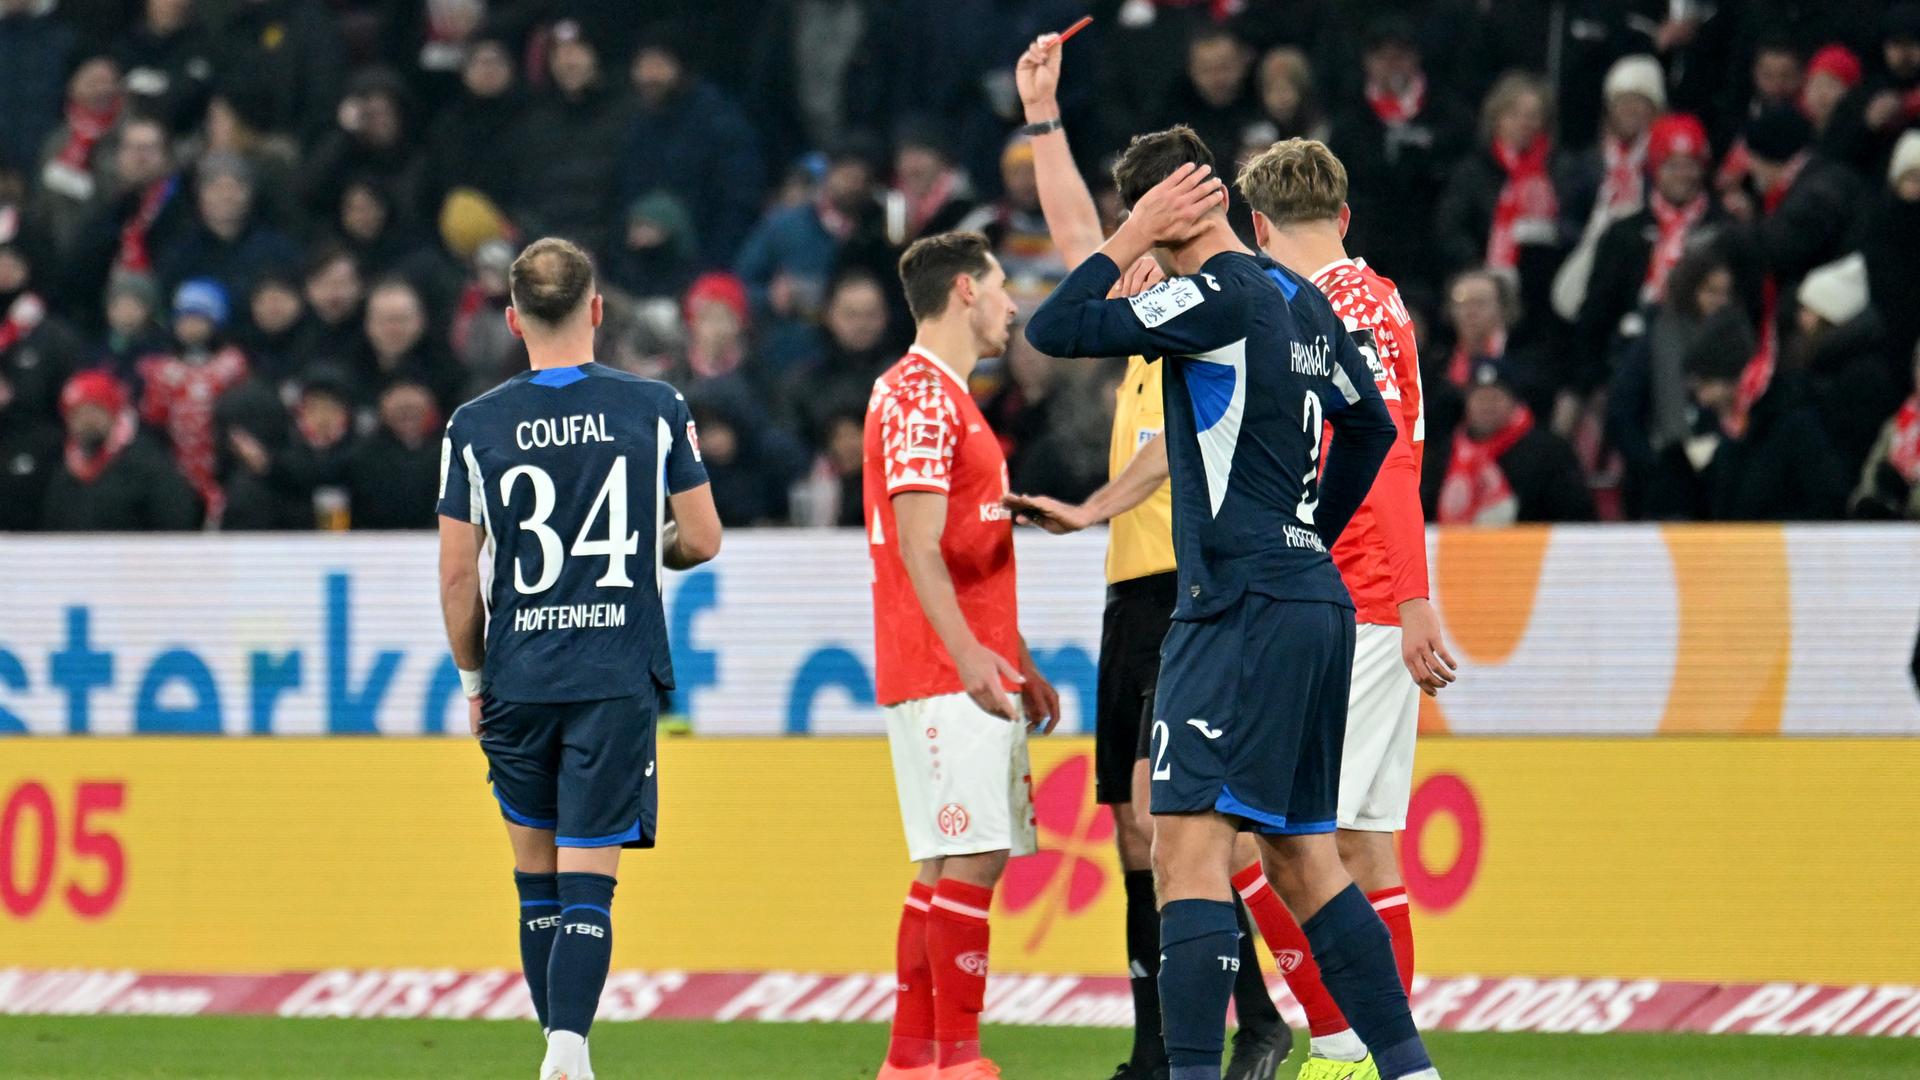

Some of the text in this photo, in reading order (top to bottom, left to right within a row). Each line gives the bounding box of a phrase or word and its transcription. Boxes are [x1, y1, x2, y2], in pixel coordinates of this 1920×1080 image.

[516, 413, 614, 450] COUFAL
[500, 455, 639, 595] 34
[514, 603, 626, 632] HOFFENHEIM
[1151, 720, 1171, 781] 2
[0, 779, 126, 919] 05
[564, 922, 605, 939] TSG
[277, 969, 460, 1018] CATS
[1454, 976, 1660, 1034] DOGS
